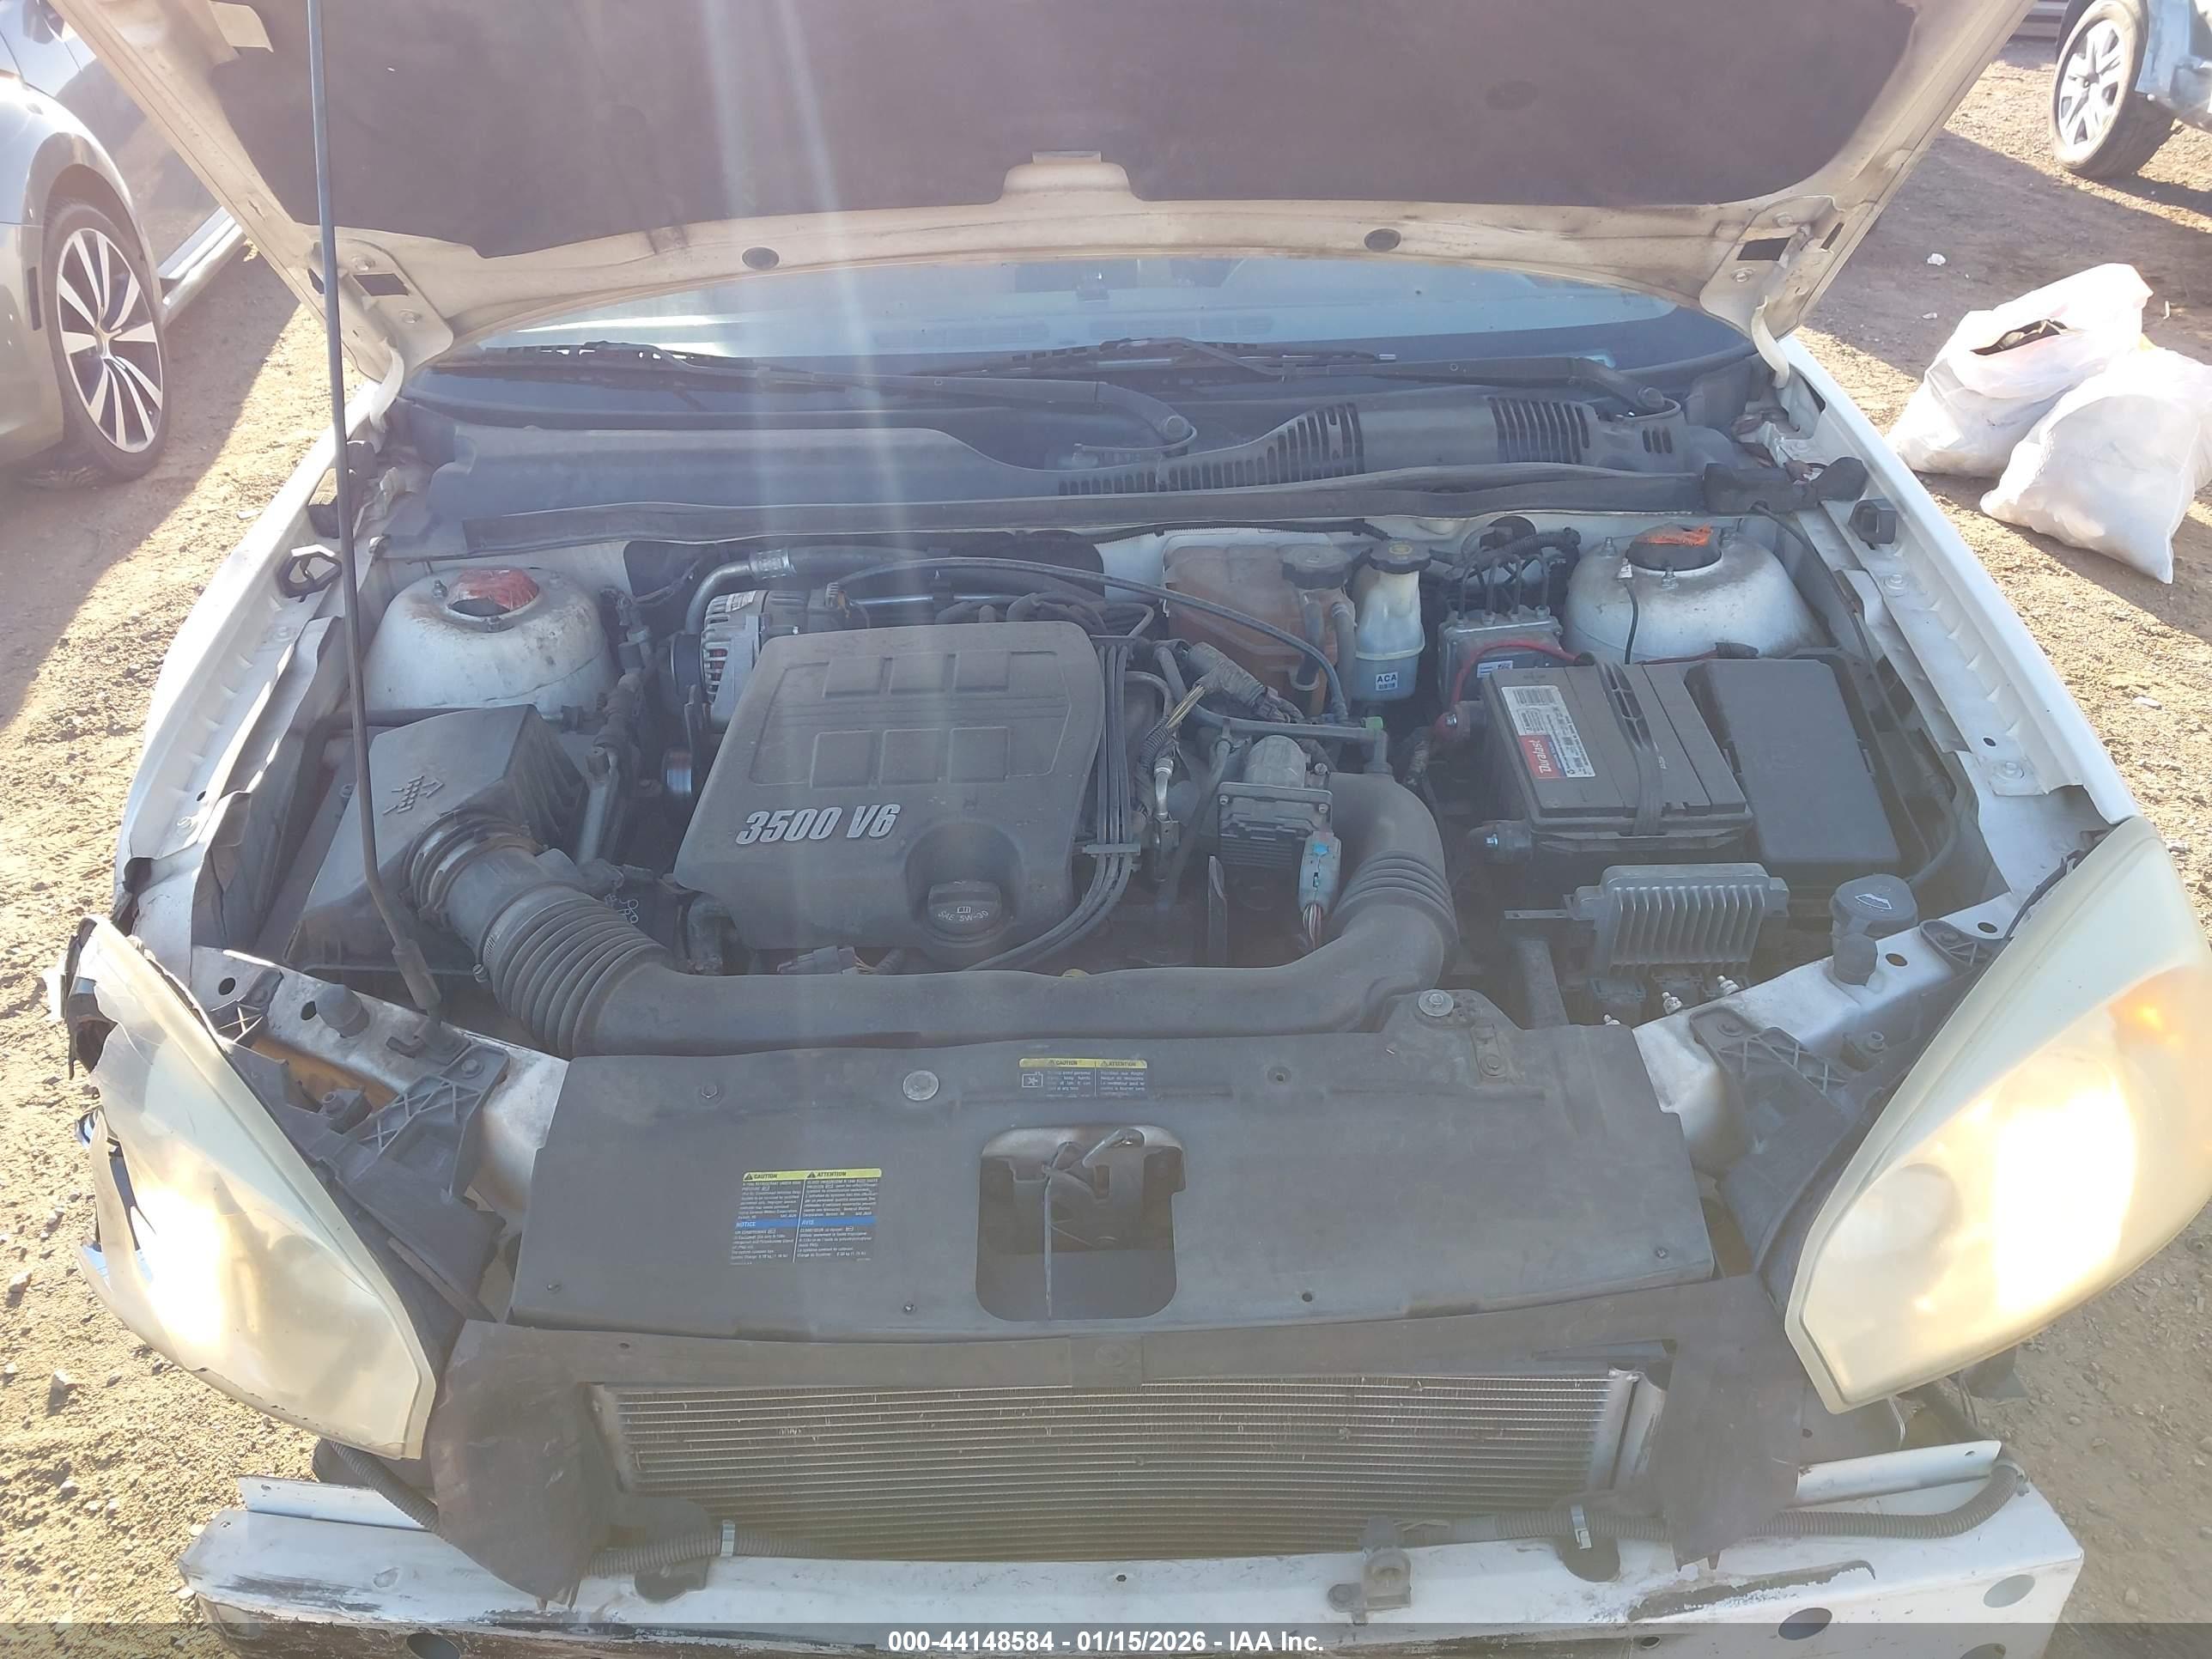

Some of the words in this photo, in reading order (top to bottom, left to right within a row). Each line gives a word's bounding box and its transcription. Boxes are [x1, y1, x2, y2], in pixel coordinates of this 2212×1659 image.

[1376, 674, 1397, 683] ACA
[1528, 739, 1553, 774] Duralast
[735, 806, 842, 845] 3500
[846, 804, 901, 839] V6
[938, 910, 955, 921] SAE
[958, 910, 989, 921] 5W-30
